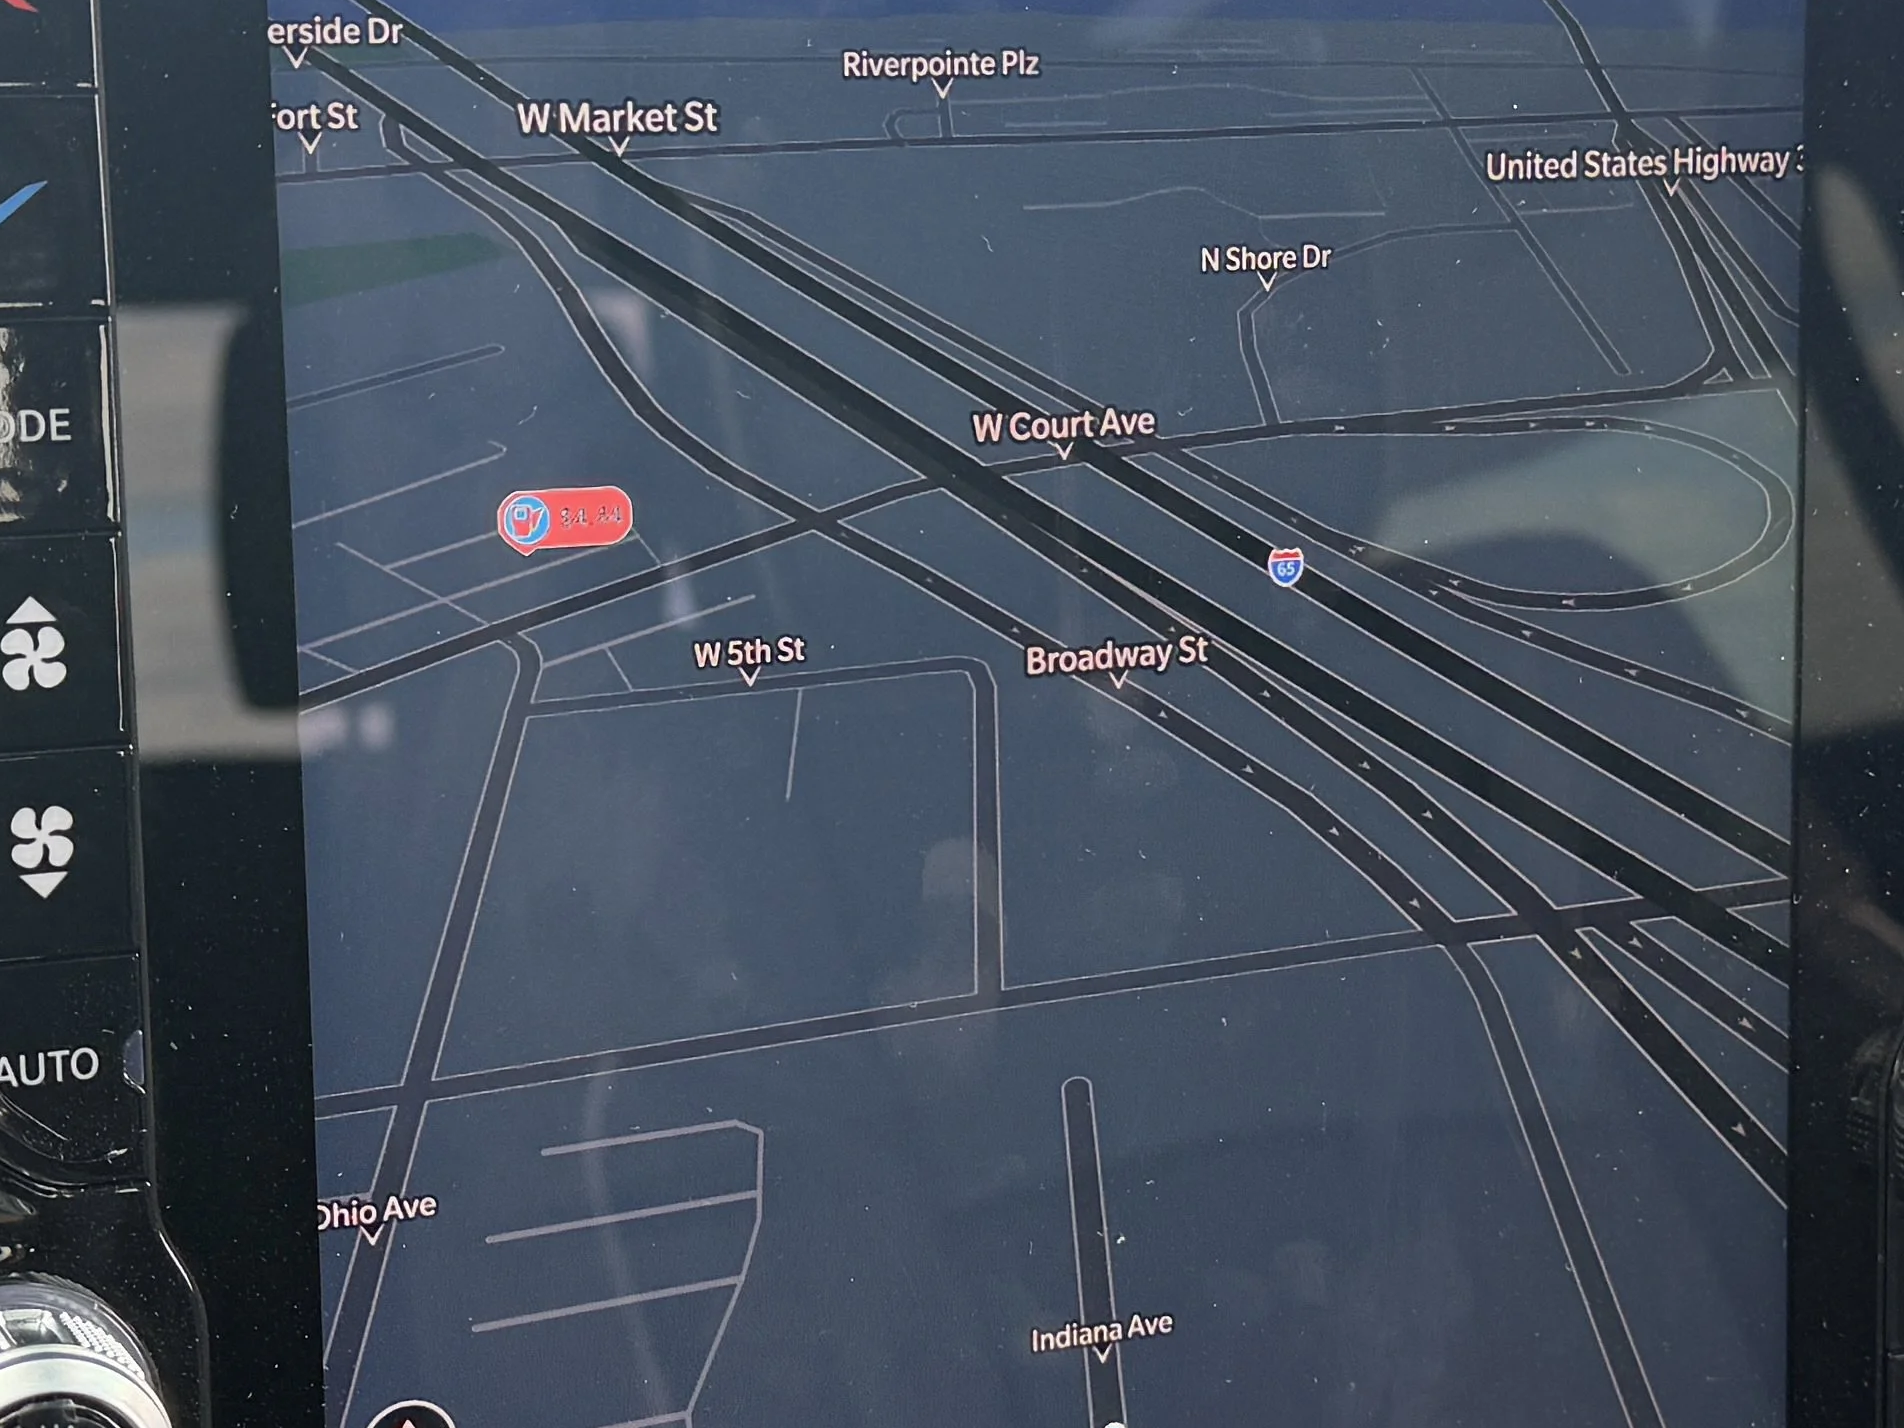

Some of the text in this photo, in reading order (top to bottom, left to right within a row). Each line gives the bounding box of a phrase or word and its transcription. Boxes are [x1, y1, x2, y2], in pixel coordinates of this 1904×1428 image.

[367, 17, 403, 45] Dr
[842, 50, 1040, 83] Riverpointe Plz
[271, 101, 359, 130] ort St
[518, 101, 718, 134] W Market St
[1486, 149, 1577, 180] United
[1584, 148, 1667, 177] States
[1673, 145, 1791, 180] Highway
[1202, 244, 1332, 272] N Shore Dr
[973, 408, 1156, 442] W Court Ave
[1276, 559, 1296, 579] 65
[694, 637, 805, 668] W 5th St
[1026, 636, 1208, 675] Broadway St
[383, 1196, 437, 1222] Ave
[1032, 1313, 1173, 1353] Indiana Ave
